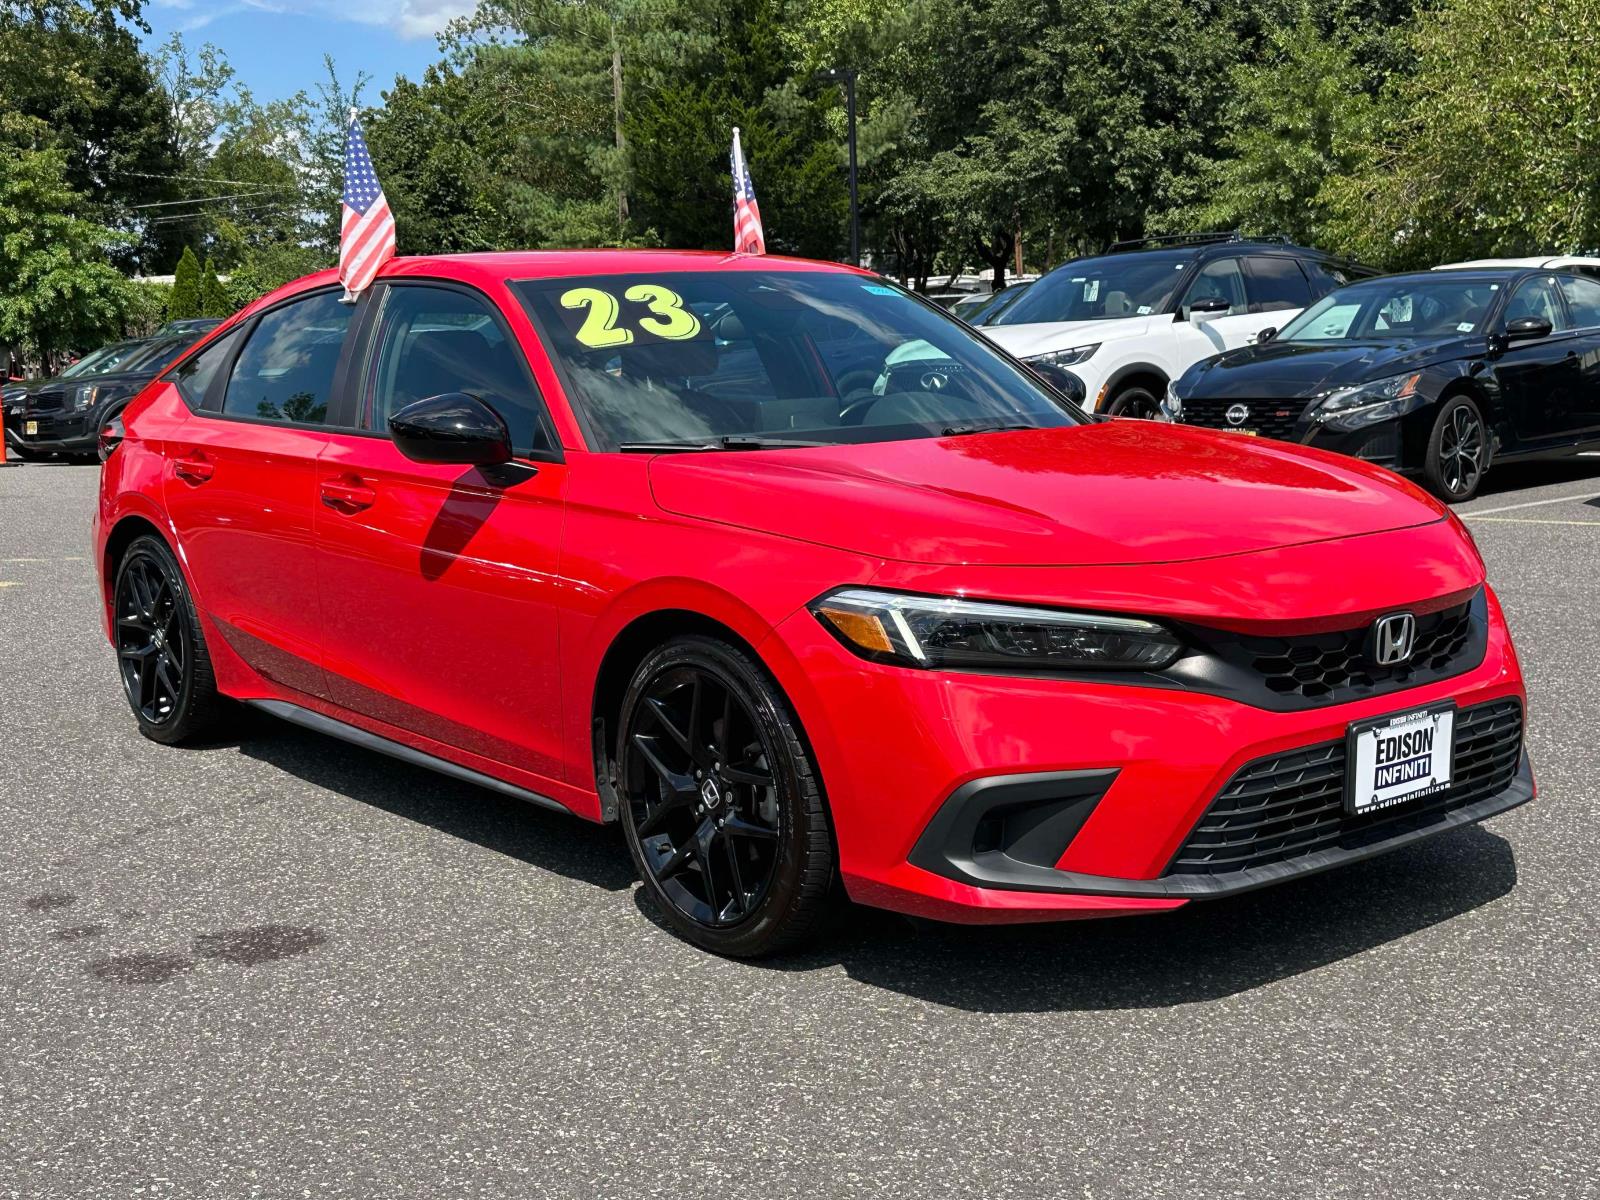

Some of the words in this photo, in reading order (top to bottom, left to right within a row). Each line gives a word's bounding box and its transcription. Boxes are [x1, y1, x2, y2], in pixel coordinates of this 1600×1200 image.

[560, 284, 701, 348] 23
[1376, 727, 1434, 765] EDISON
[1377, 758, 1429, 787] INFINITI
[1357, 782, 1451, 814] www.edisoninfiniti.com
